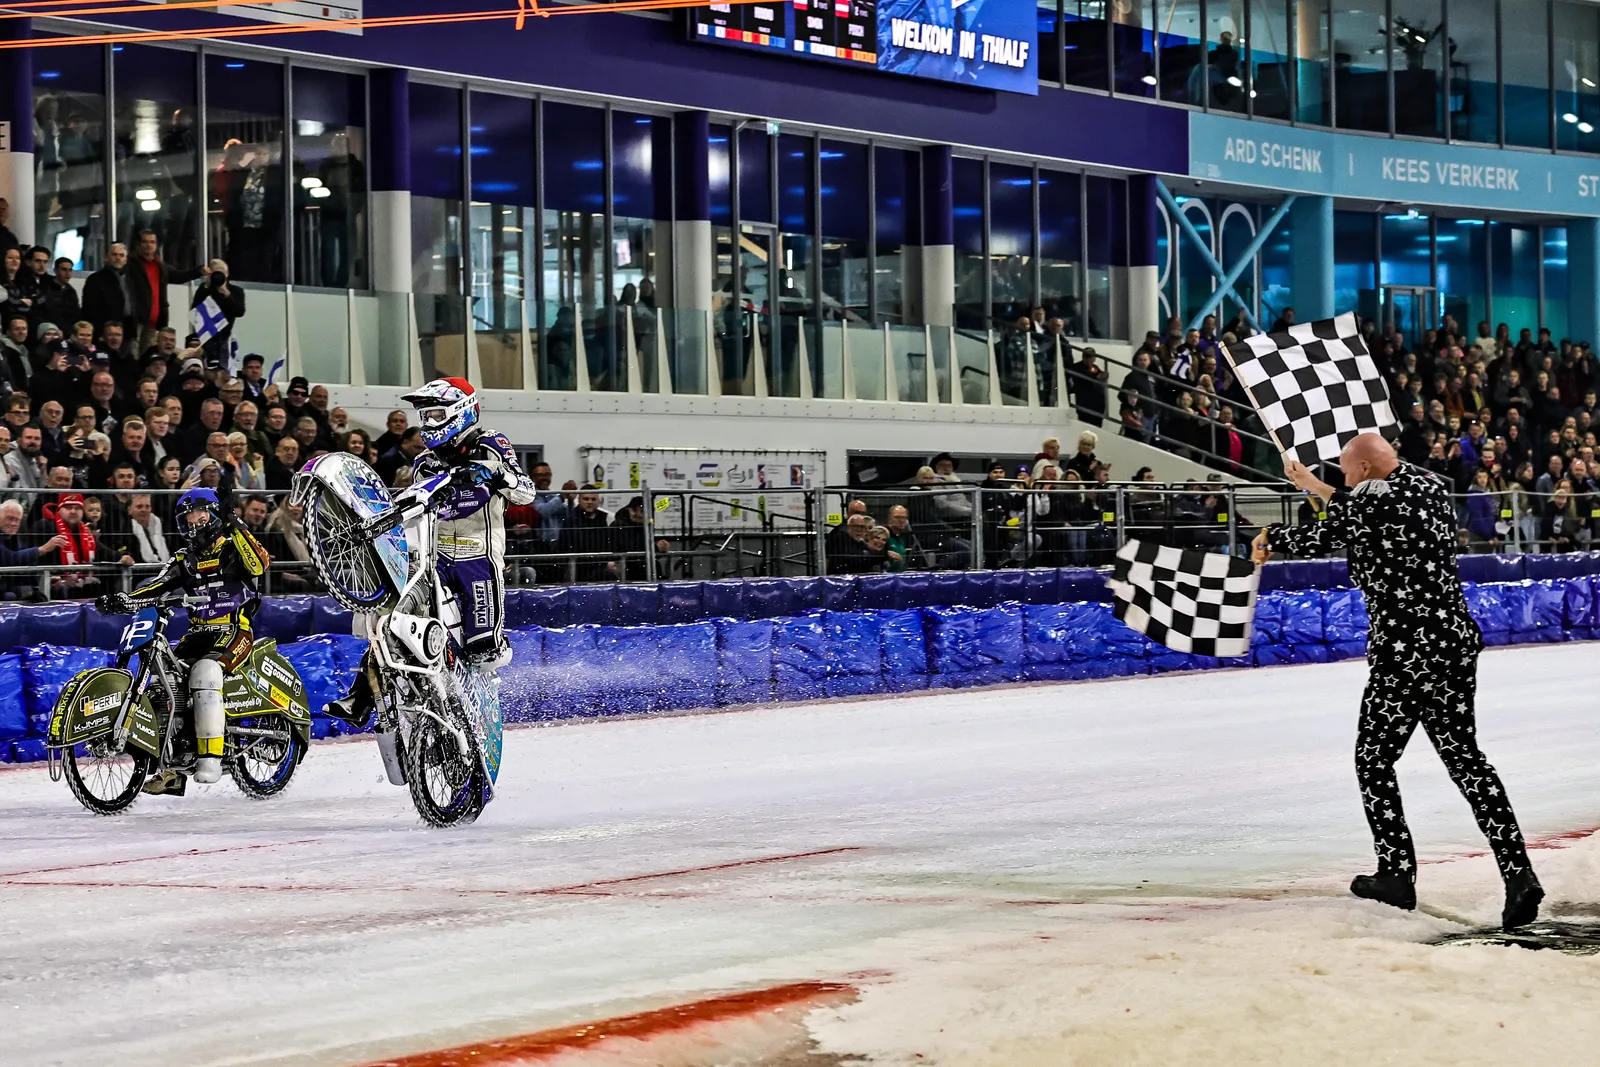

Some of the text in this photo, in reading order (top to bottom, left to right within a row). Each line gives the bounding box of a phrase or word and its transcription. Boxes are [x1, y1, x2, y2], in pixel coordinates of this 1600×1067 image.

[891, 17, 953, 55] WELKOM
[959, 30, 976, 59] IN
[981, 34, 1029, 68] THIALF
[1224, 137, 1600, 197] ARD SCHENK KEES VERKERK ST
[242, 543, 257, 567] WACO
[475, 584, 486, 624] DYNASET
